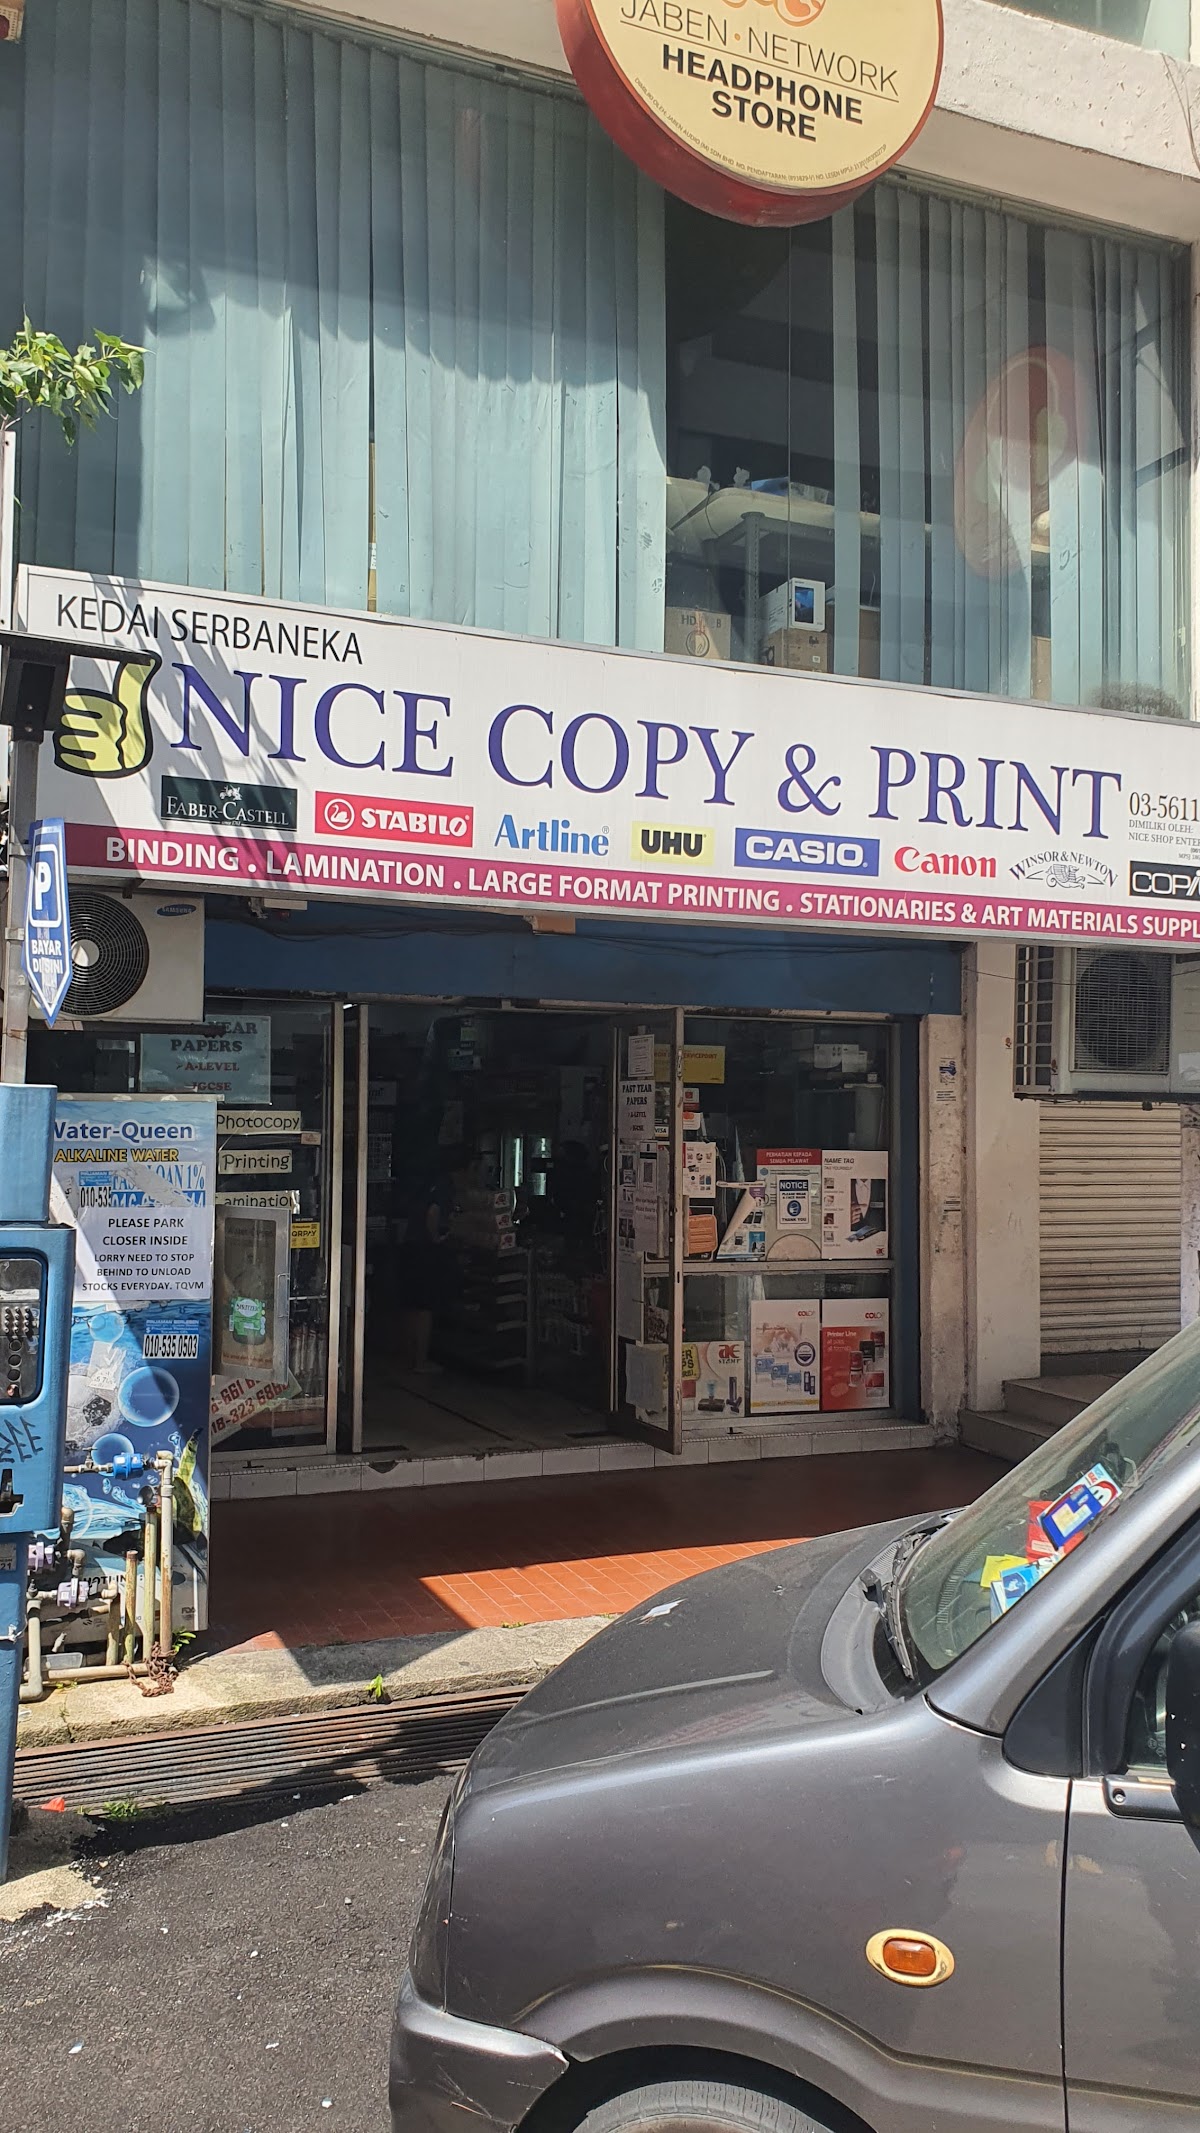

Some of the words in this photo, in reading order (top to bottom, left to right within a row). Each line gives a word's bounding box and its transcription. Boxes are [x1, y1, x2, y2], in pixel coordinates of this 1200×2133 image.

[621, 0, 727, 47] JABEN
[748, 27, 899, 97] NETWORK
[662, 44, 863, 125] HEADPHONE
[711, 90, 817, 142] STORE
[57, 593, 159, 639] KEDAI
[171, 608, 363, 665] SERBANEKA
[169, 662, 454, 778] NICE
[488, 704, 755, 806] COPY
[777, 743, 842, 817] &
[868, 745, 1122, 840] PRINT
[166, 796, 289, 826] FABER-CASTELL
[360, 807, 470, 838] STABILO
[1129, 819, 1166, 831] DIMILIKI
[641, 829, 703, 858] UHU
[1128, 832, 1149, 842] NICE
[1151, 834, 1174, 844] SHOP
[745, 835, 865, 868] CASIO
[894, 847, 997, 878] Canon
[35, 861, 52, 910] P
[106, 837, 239, 872] BINDING
[266, 850, 444, 888] LAMINATION
[468, 867, 552, 897] LARGE
[559, 876, 663, 902] FORMAT
[668, 883, 780, 913] PRINTING
[800, 892, 956, 923] STATIONARIES
[961, 904, 977, 924] &
[981, 904, 1021, 927] ART
[1027, 909, 1138, 935] MATERIALS
[32, 939, 62, 956] BAYAR
[170, 1039, 243, 1053] PAPERS
[217, 1114, 300, 1130] Photocopy
[54, 1149, 127, 1162] ALKALINE
[131, 1149, 179, 1162] WATER
[222, 1154, 290, 1170] Printing
[108, 1218, 150, 1228] PLEASE
[153, 1218, 184, 1228] PARK
[102, 1236, 146, 1246] CLOSER
[150, 1236, 188, 1245] INSIDE
[95, 1254, 125, 1262] LORRY
[171, 1253, 195, 1261] STOP
[97, 1268, 133, 1276] BEHIND
[136, 1268, 148, 1276] TO
[151, 1267, 191, 1276] UNLOAD
[82, 1283, 118, 1291] STOCKS
[121, 1282, 172, 1291] EVERYDAY.
[175, 1281, 204, 1290] TQVM
[144, 1335, 177, 1357] 010-535
[178, 1335, 197, 1357] 0503
